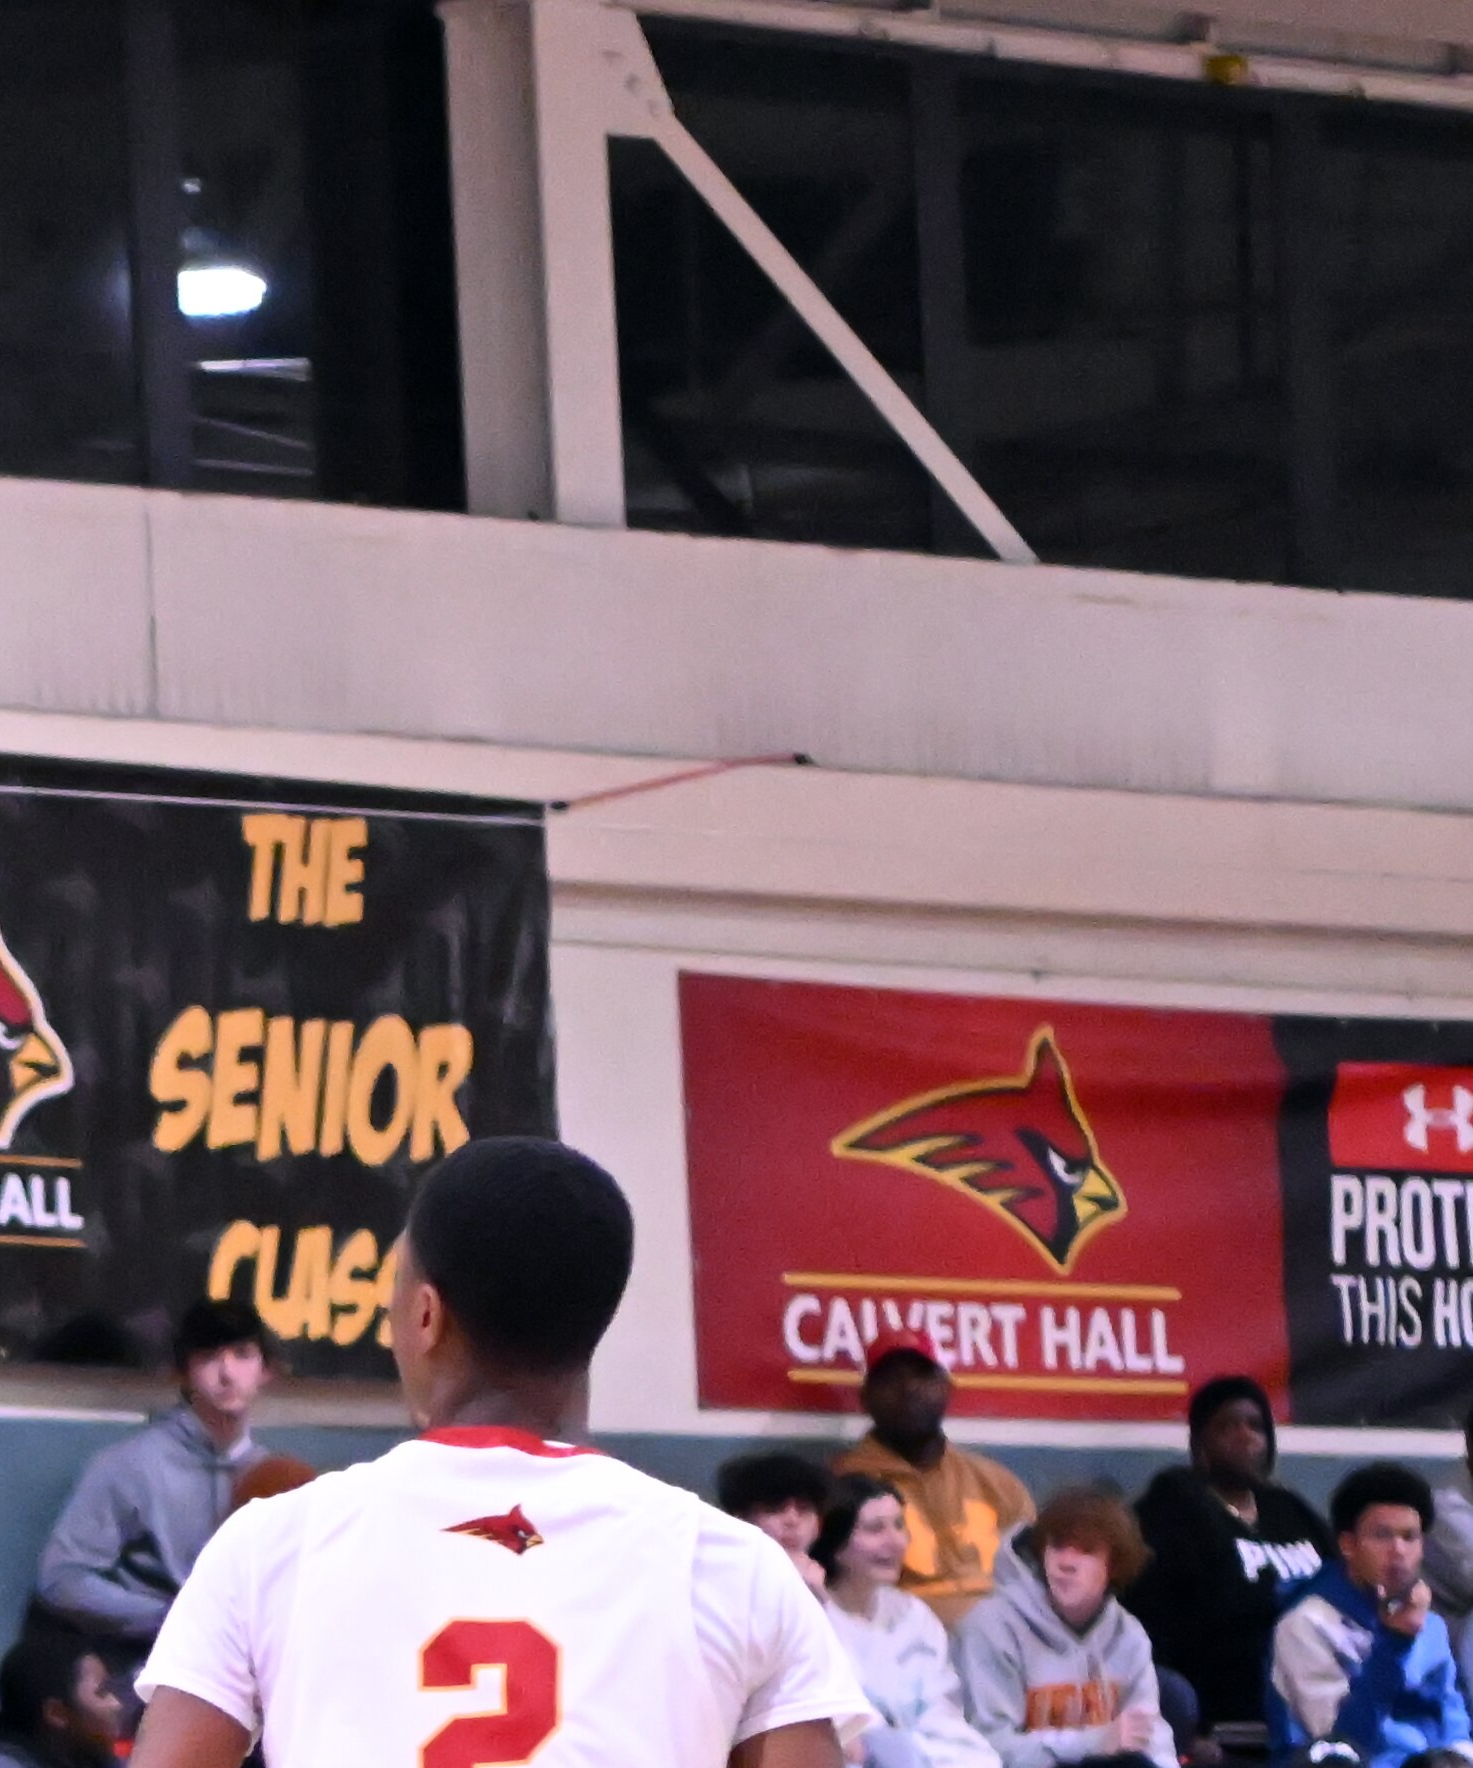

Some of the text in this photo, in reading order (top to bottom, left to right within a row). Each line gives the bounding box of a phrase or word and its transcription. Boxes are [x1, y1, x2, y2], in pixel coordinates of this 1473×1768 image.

[241, 813, 370, 927] THE
[149, 1005, 475, 1166] SENIOR
[1040, 1304, 1186, 1374] HALL
[1330, 1273, 1423, 1348] THIS
